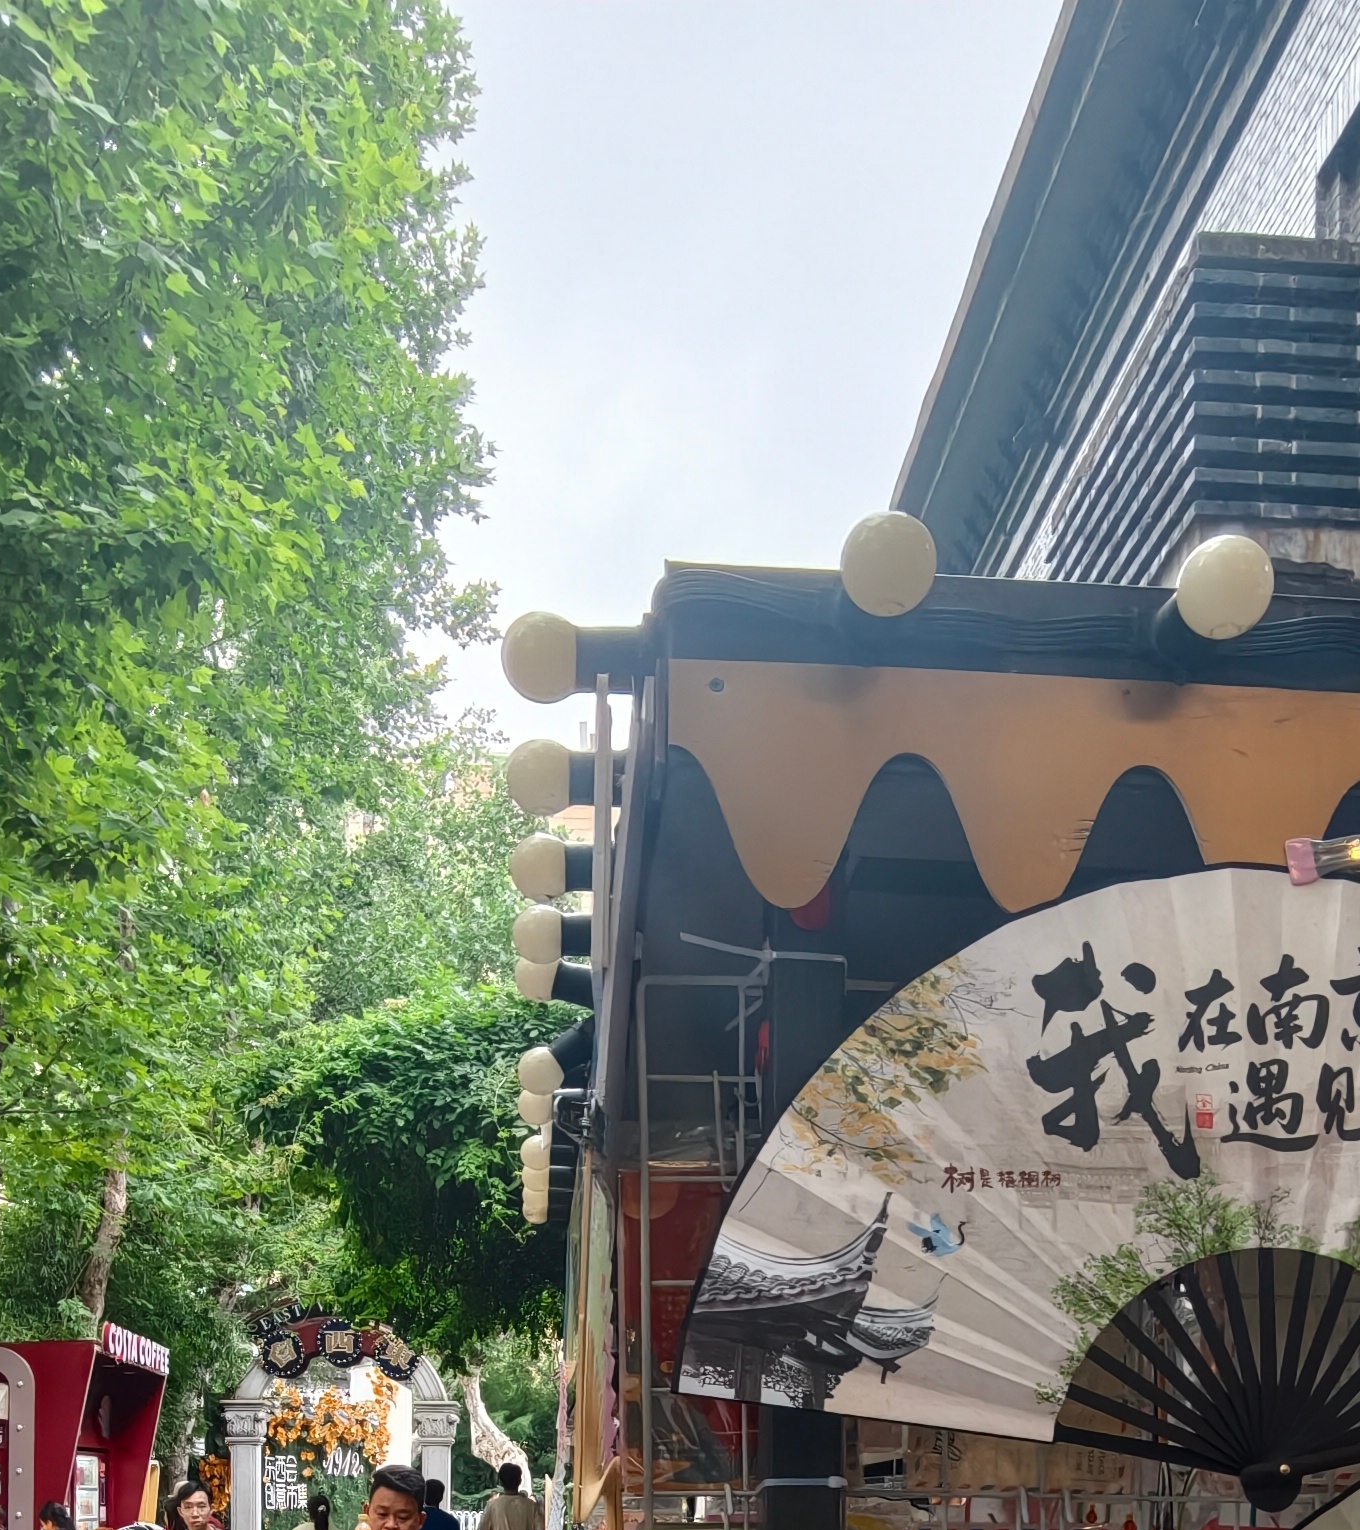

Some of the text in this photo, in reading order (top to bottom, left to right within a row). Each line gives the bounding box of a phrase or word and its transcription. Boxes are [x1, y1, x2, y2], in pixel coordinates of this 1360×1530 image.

[941, 1163, 1062, 1194] 树是梧桐树
[109, 1322, 171, 1375] COSTA COFFEE
[323, 1447, 364, 1478] 1912
